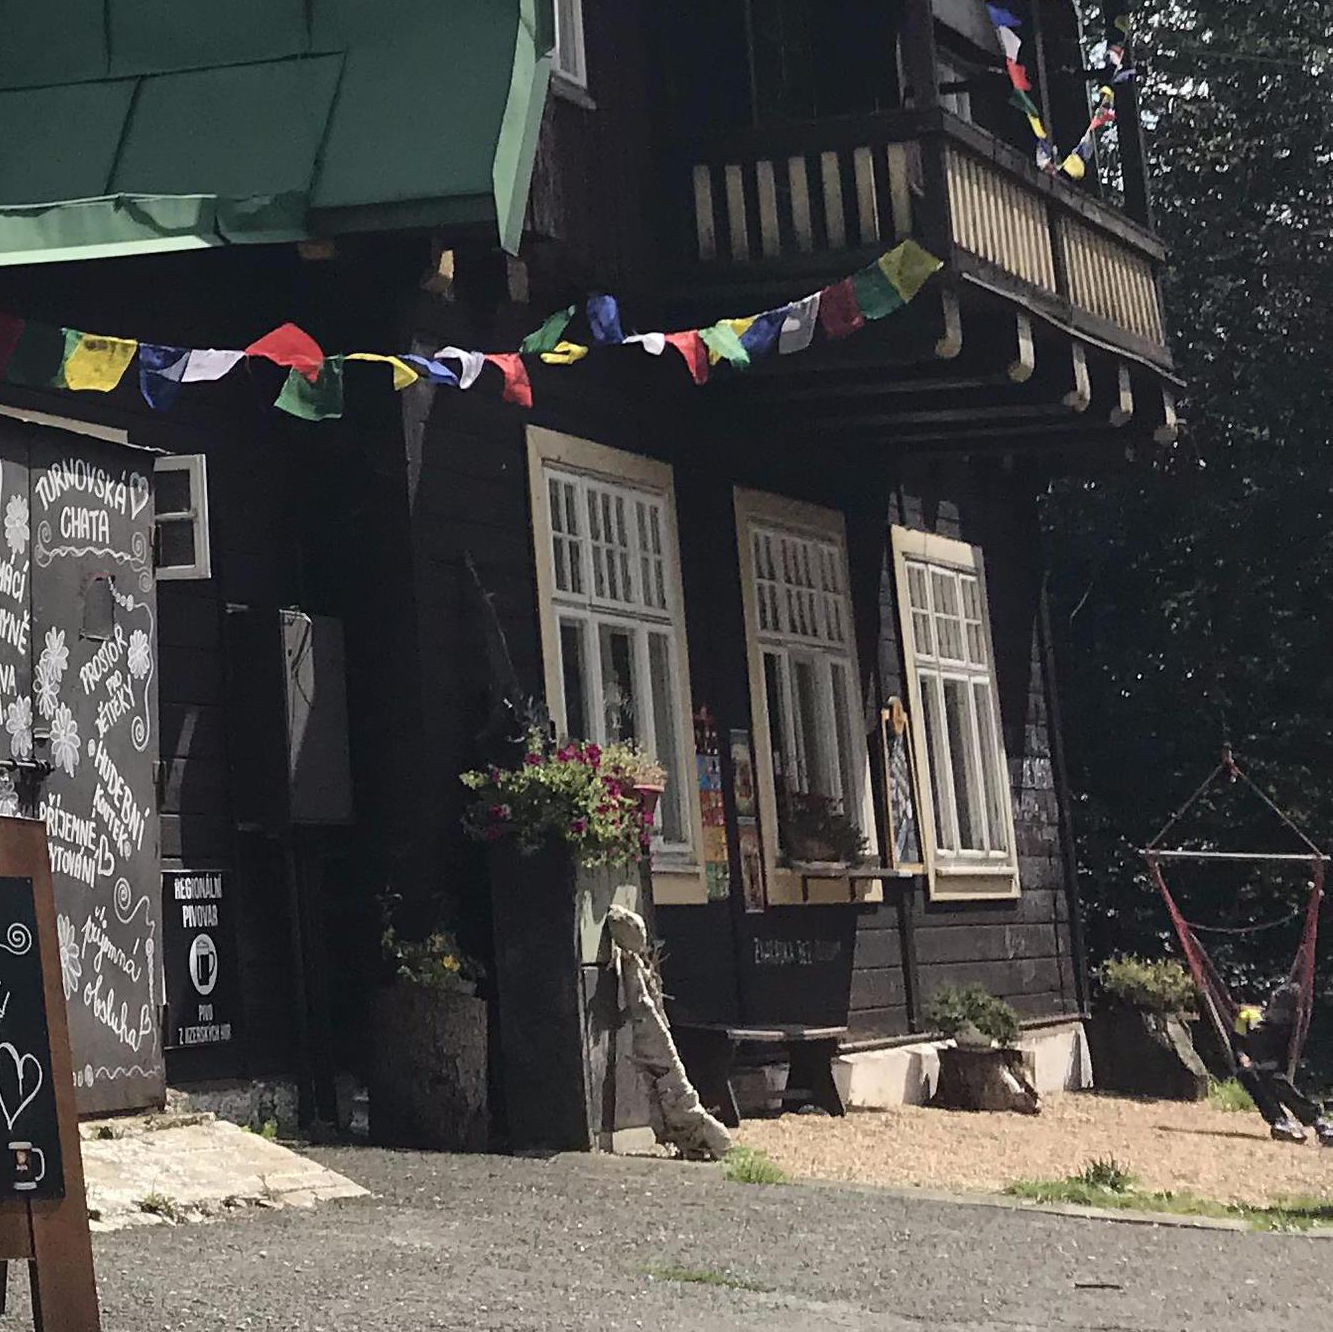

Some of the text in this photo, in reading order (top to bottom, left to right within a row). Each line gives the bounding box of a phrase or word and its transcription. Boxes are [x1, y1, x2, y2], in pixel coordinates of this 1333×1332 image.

[35, 458, 128, 515] TURNOVSKÁ
[60, 506, 110, 544] CHATA
[79, 623, 129, 695] PROSTOR
[106, 669, 124, 699] PRO
[39, 791, 99, 848] PŘÍJEMNÉ
[95, 743, 151, 850] HUDEBNÍ
[48, 841, 100, 889] YTOVÁNÍ
[174, 873, 223, 900] REGIONÁLNÍ
[182, 904, 219, 928] PIVOVAR
